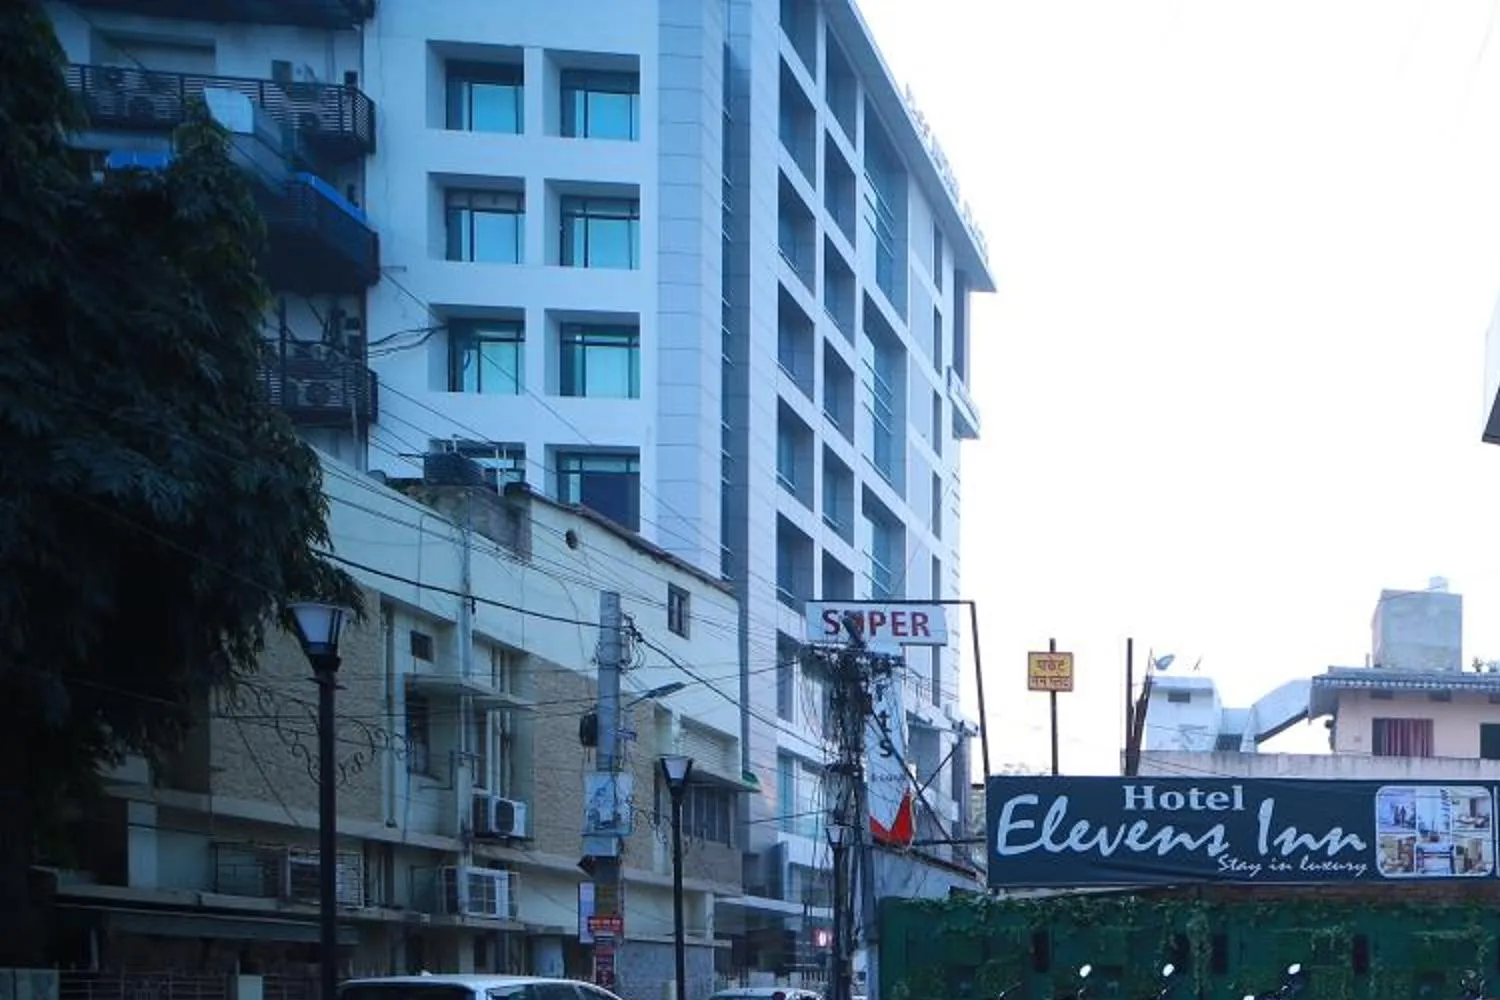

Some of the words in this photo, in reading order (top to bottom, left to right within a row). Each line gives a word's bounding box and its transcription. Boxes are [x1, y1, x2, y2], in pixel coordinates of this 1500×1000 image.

[1122, 785, 1246, 811] Hotel
[997, 794, 1230, 856] Elevens
[1257, 797, 1367, 856] Inn
[1217, 853, 1262, 877] Stay
[1268, 857, 1293, 871] in
[1299, 854, 1368, 877] luxury
